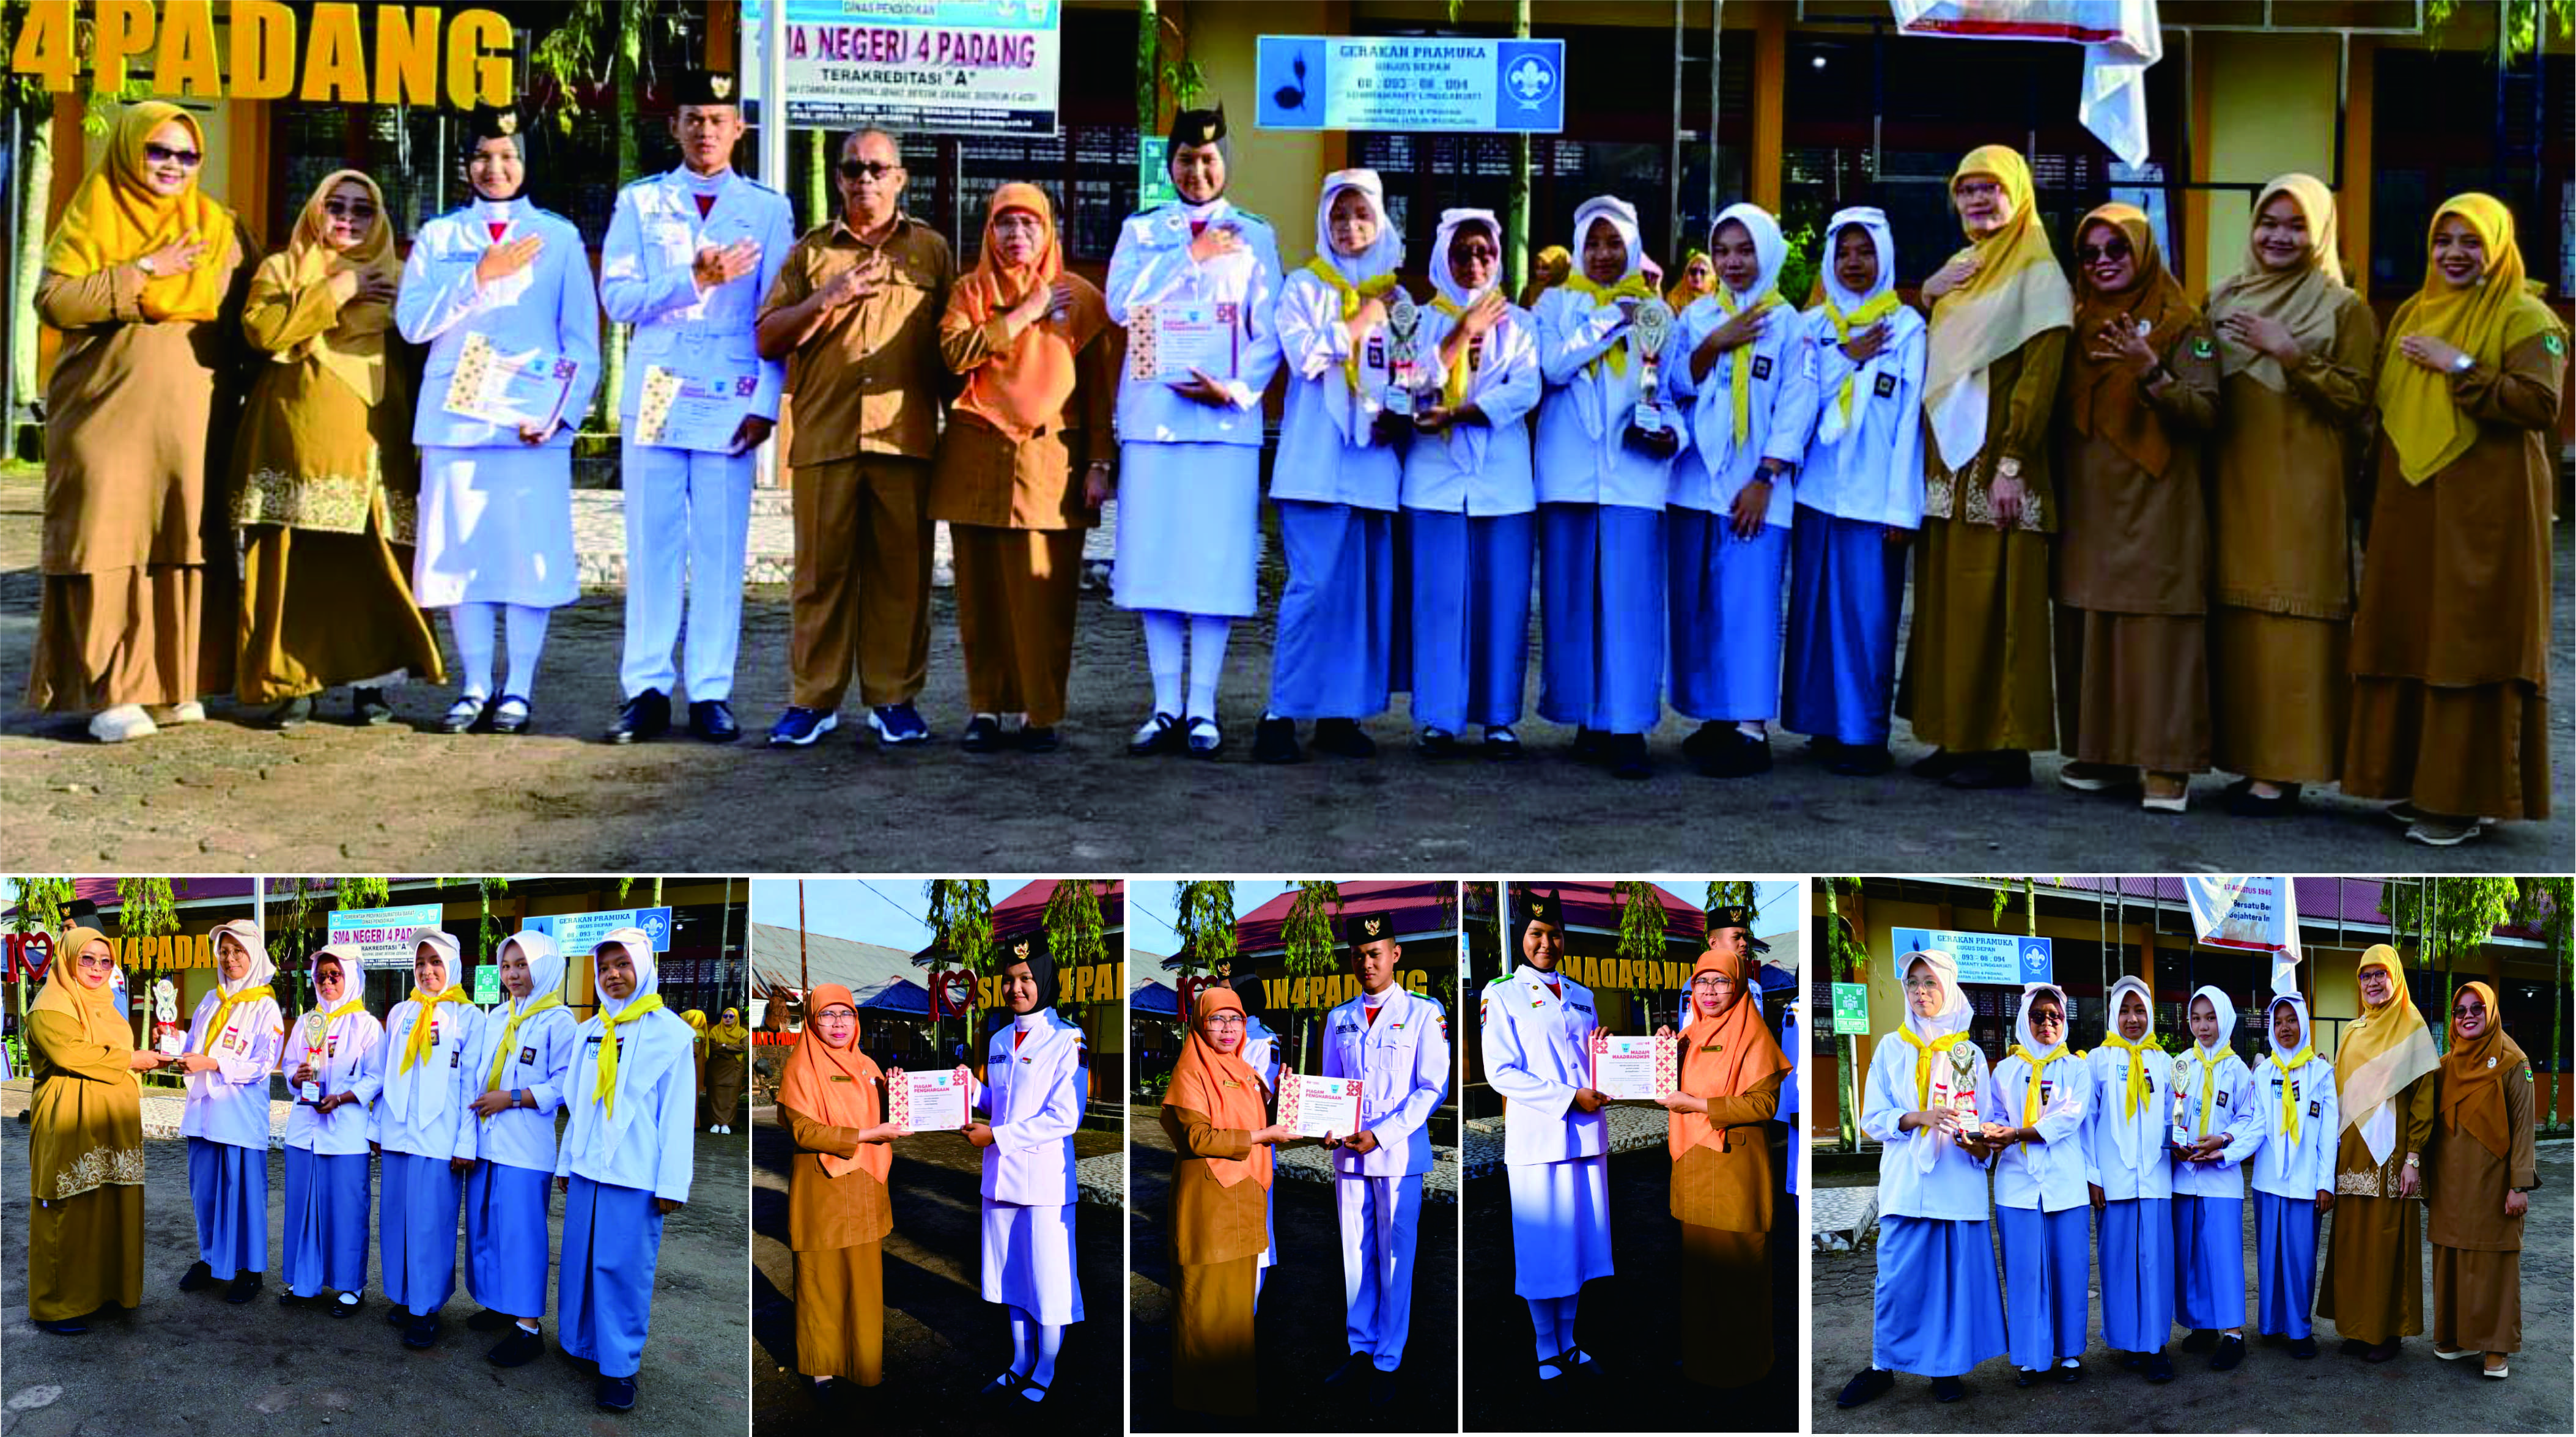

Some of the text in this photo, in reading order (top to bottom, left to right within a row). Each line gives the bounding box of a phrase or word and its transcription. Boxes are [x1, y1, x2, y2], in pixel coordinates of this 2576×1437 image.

[817, 26, 907, 62] NEGERI
[917, 31, 930, 62] 4
[938, 32, 1035, 67] PADANG
[822, 68, 942, 85] TERAKREDITASI
[2232, 885, 2256, 894] AGUSTUS
[333, 928, 416, 944] SMA NEGERI 4 PAD
[1937, 935, 2013, 946] GERAKAN PRAMUKA
